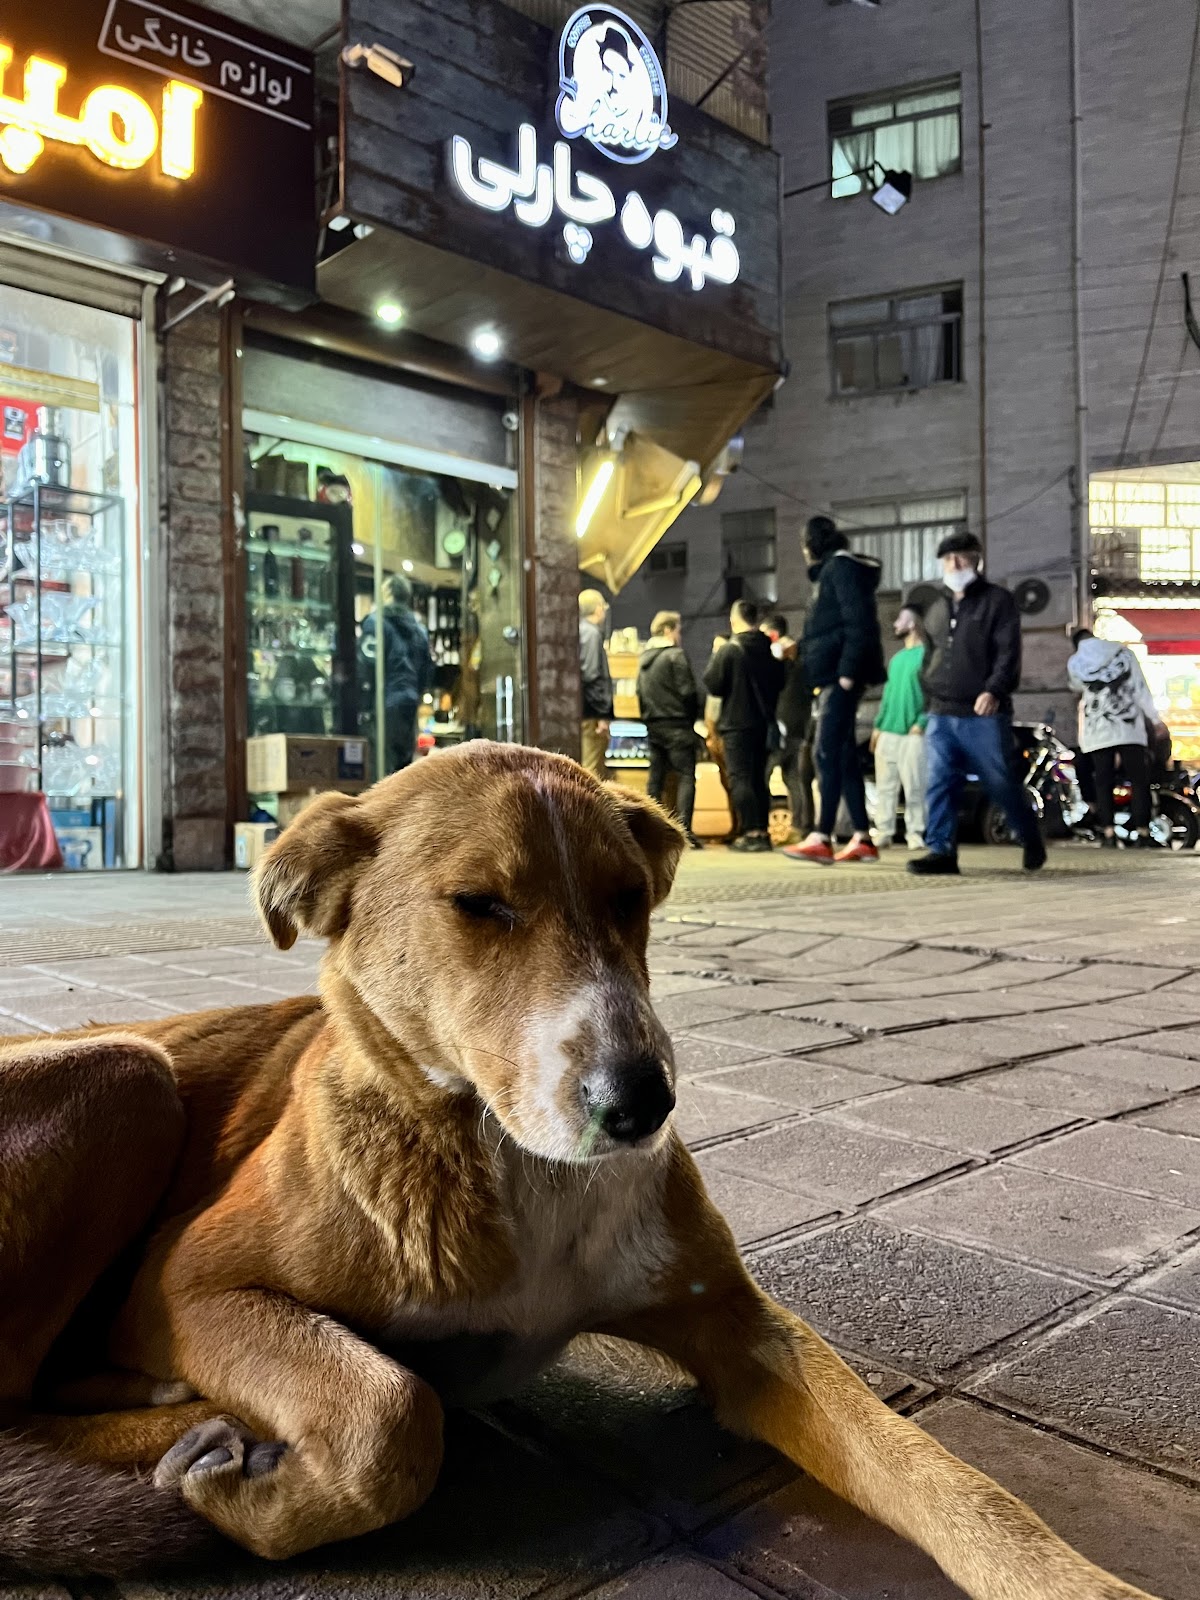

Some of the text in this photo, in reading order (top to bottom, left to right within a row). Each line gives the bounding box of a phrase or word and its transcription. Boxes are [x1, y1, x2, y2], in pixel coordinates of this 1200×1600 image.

[115, 18, 292, 105] لوازم خانگی
[452, 123, 740, 291] قهوه چارلی
